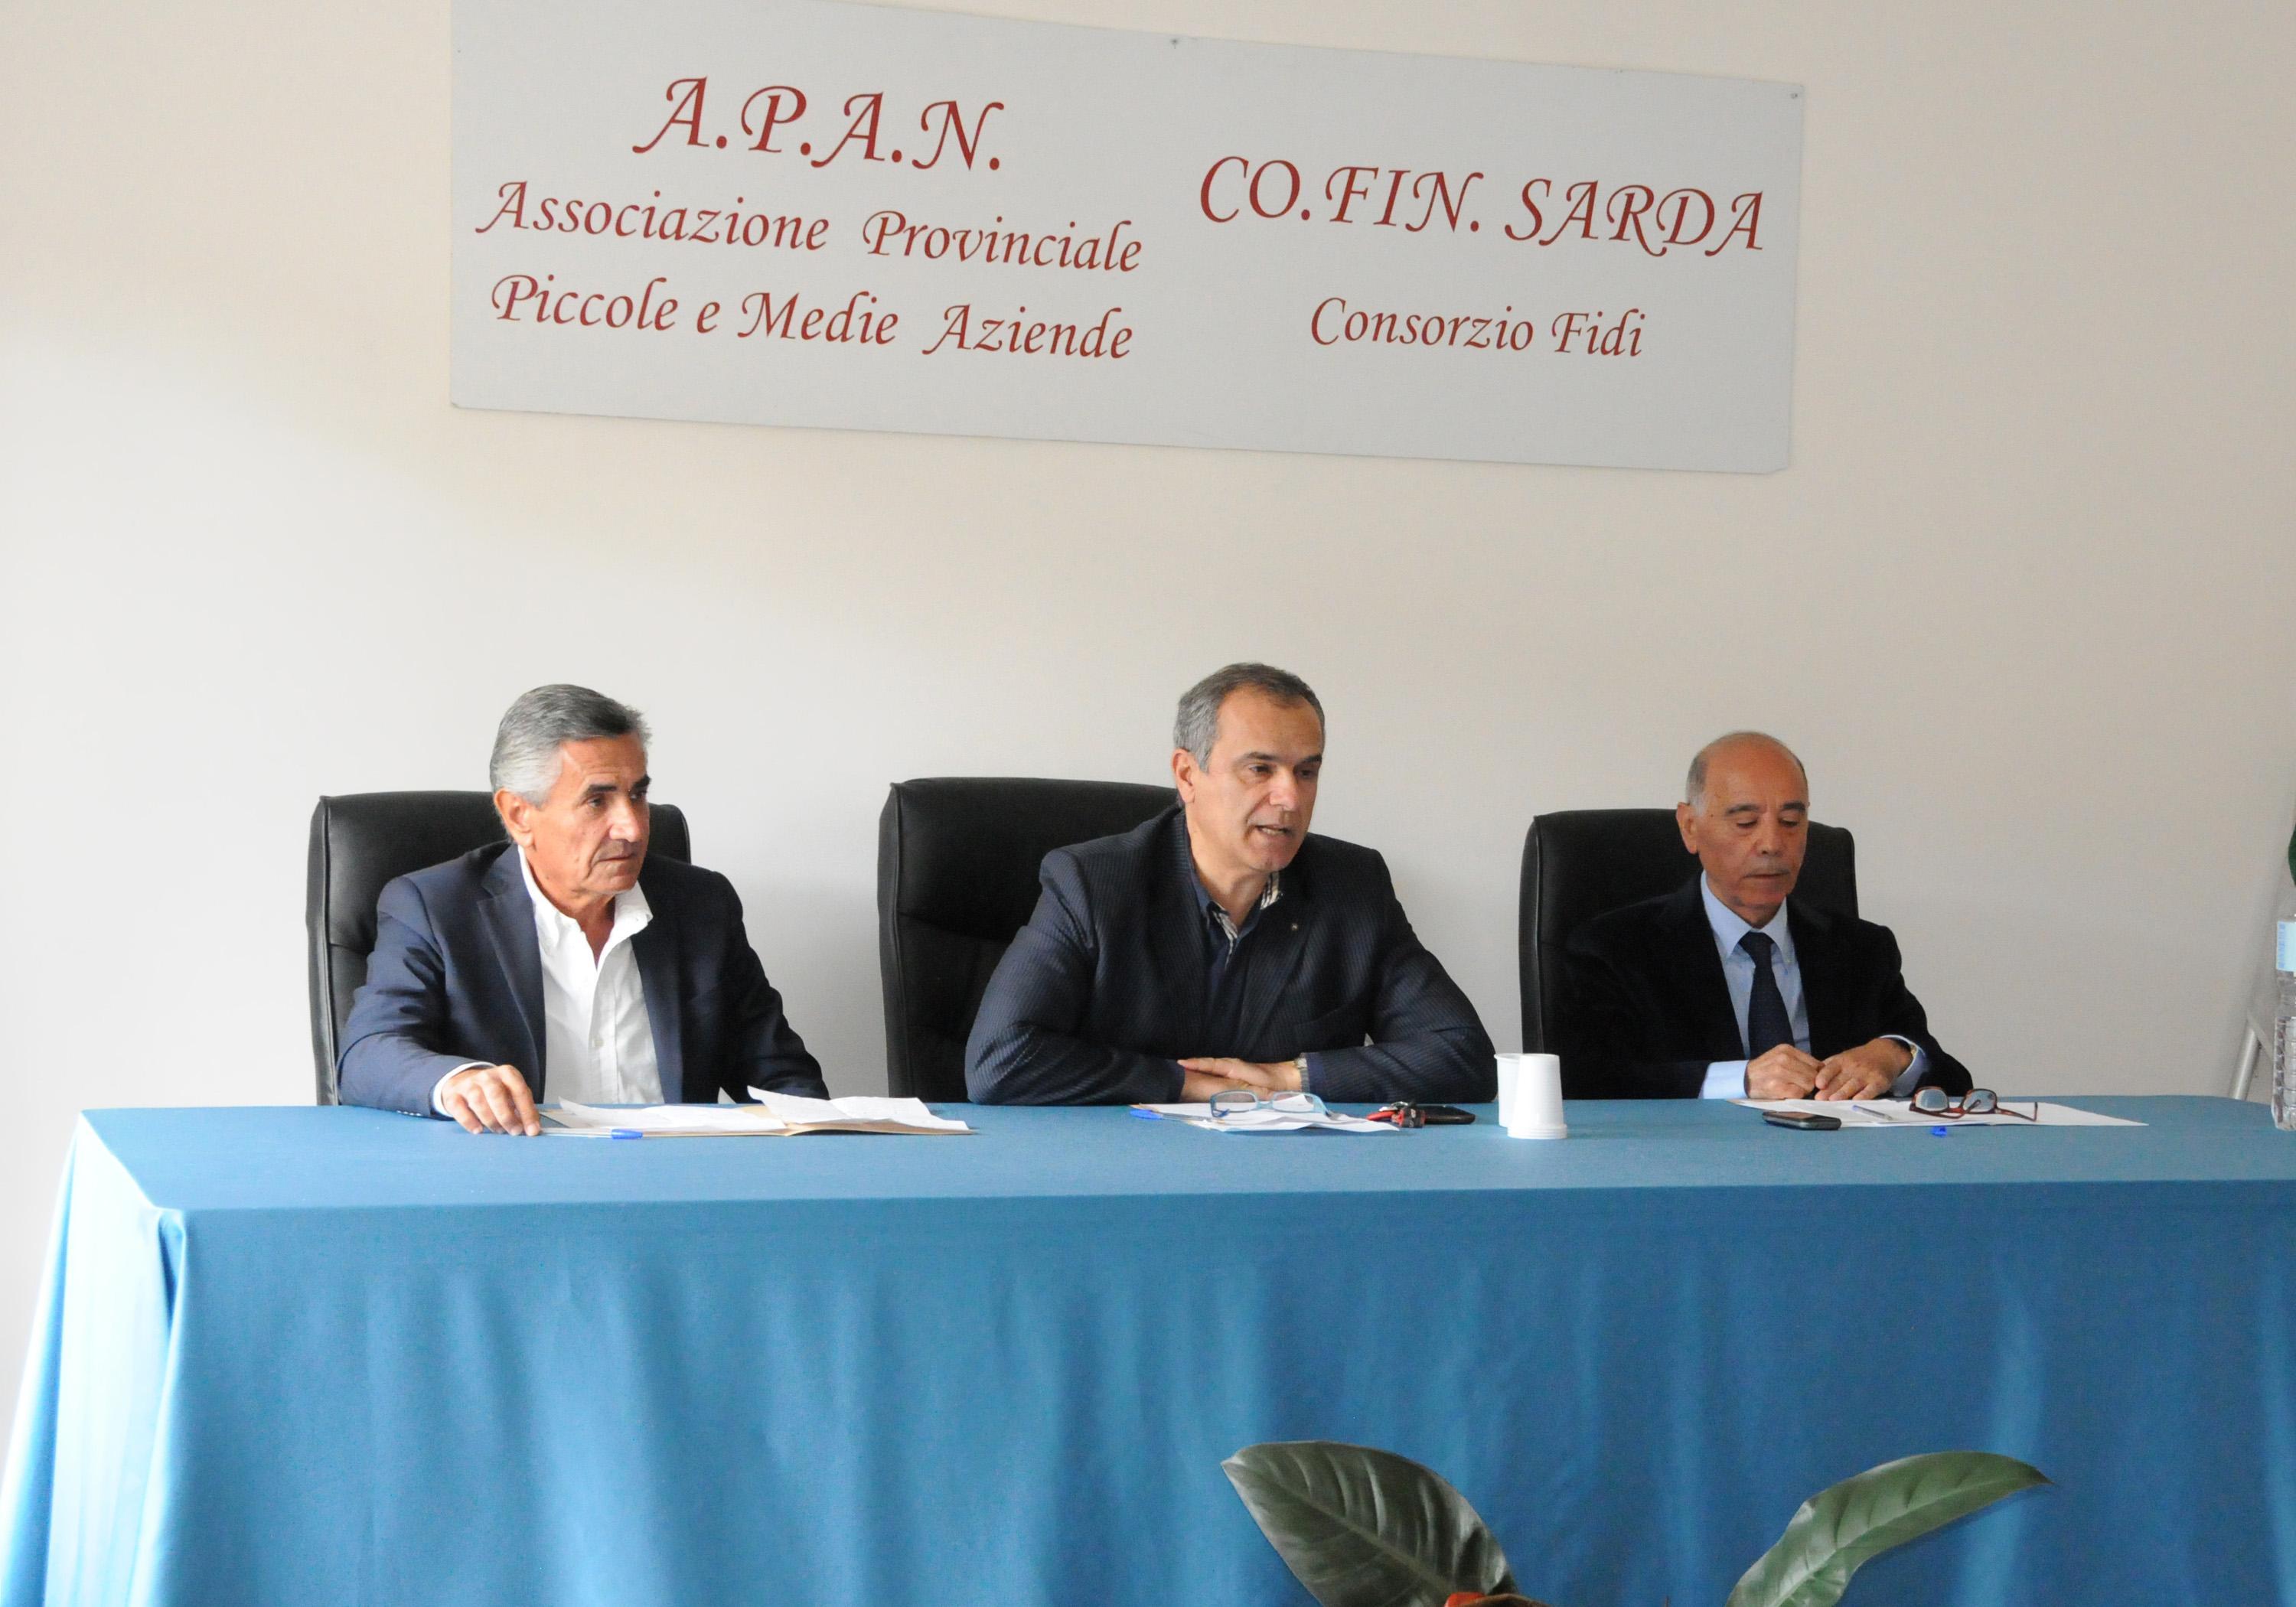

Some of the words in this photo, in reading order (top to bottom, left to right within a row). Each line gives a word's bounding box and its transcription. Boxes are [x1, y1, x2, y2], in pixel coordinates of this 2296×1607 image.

[632, 77, 1005, 171] A.P.A.N.
[475, 181, 830, 252] Associazione
[863, 211, 1143, 273] Provinciale
[1200, 156, 1484, 233] CO.FIN.
[1505, 178, 1763, 257] SARDA
[491, 274, 679, 331] Piccole
[696, 302, 721, 334] e
[738, 291, 899, 346] Medie
[921, 305, 1133, 359] Aziende
[1310, 297, 1534, 351] Consorzio
[1551, 308, 1645, 357] Fidi
